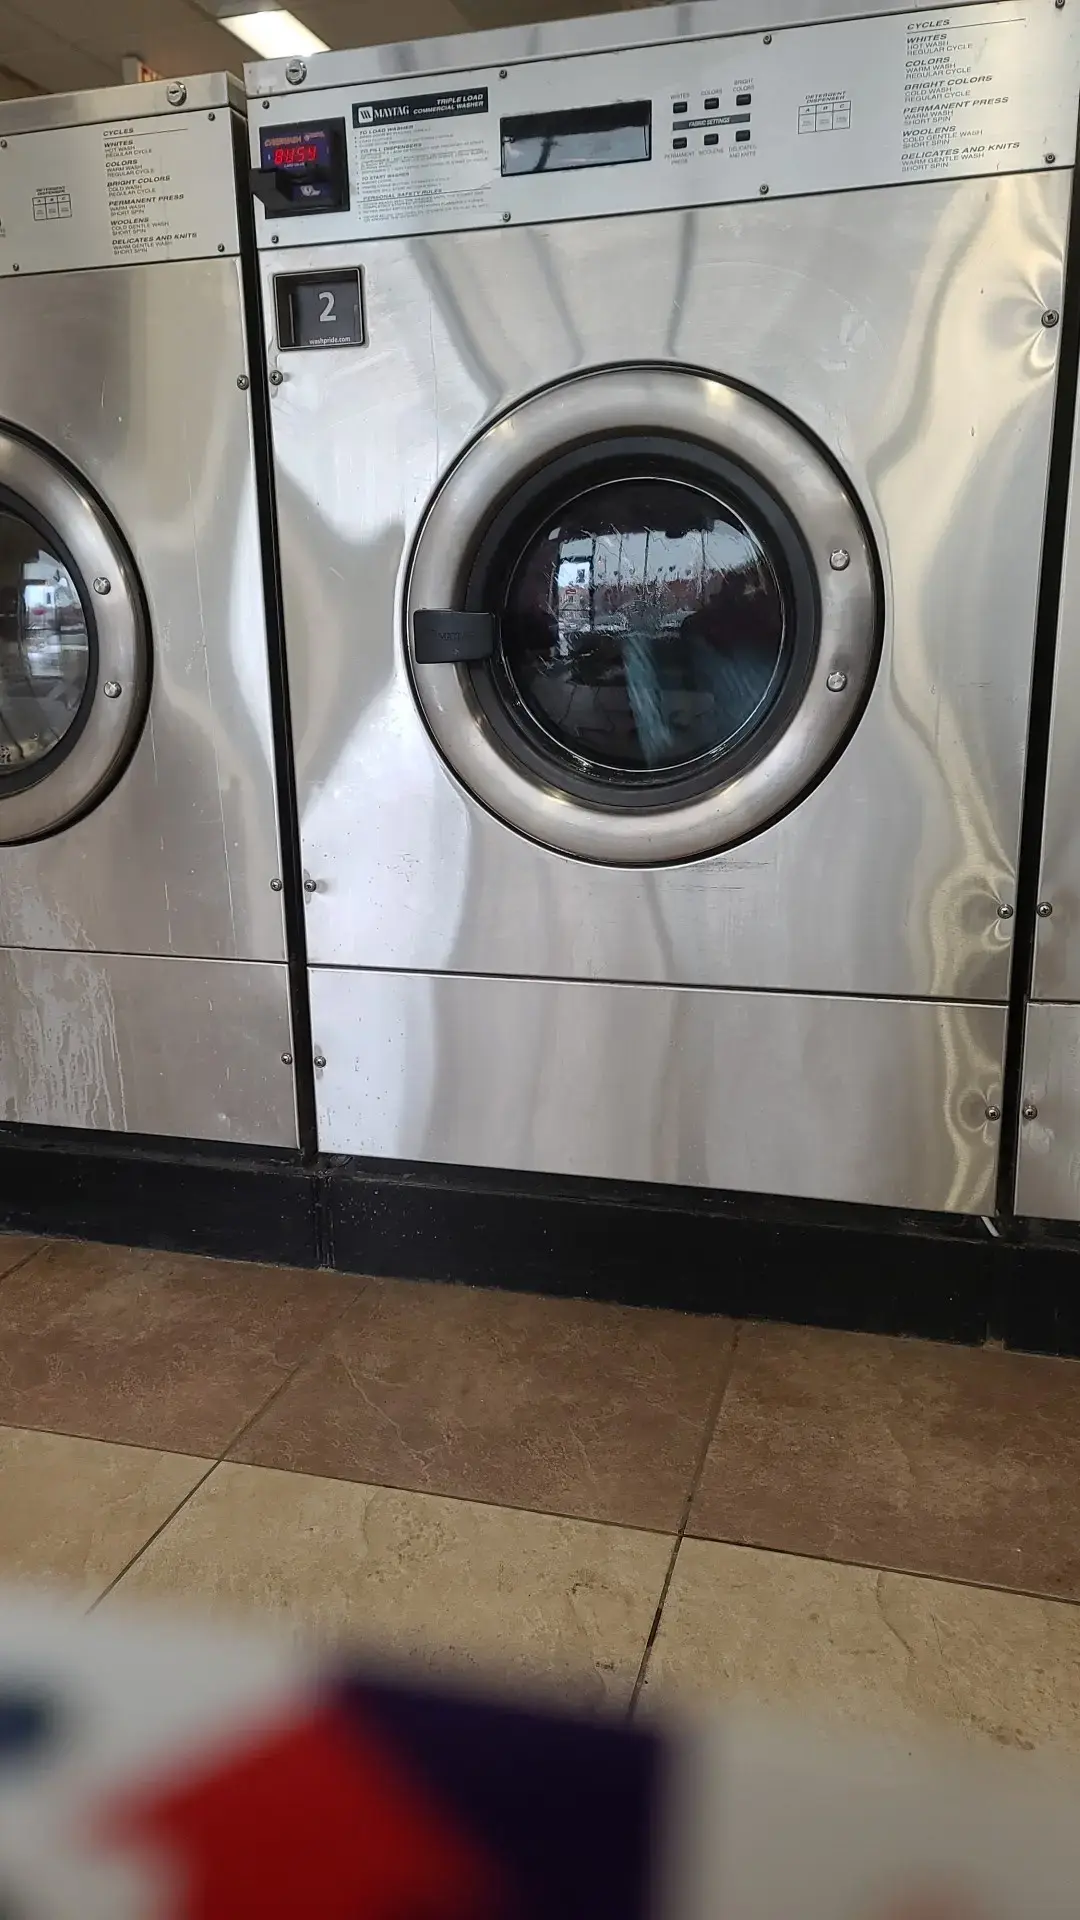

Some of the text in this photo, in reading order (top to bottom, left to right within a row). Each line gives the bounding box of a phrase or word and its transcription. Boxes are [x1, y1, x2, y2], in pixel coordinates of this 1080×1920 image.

[907, 20, 949, 30] CYCLES
[907, 34, 947, 43] WHITES
[907, 43, 973, 56] REGULAR CYCLE
[905, 57, 950, 67] COLORS
[906, 67, 971, 79] REGULAR CYCLE
[905, 75, 992, 90] BRIGHT COLORS
[905, 89, 926, 97] COLD
[905, 90, 970, 102] REGULAR CYCLE
[437, 94, 483, 105] TRIPLE LOAD
[413, 105, 455, 115] COMMERCIAL
[903, 97, 1008, 114] PERMANENT PRESS
[374, 106, 409, 119] MAYTAG
[689, 117, 730, 128] FABRIC SETTINGS
[103, 128, 133, 137] CYCLES
[903, 126, 956, 137] WOOLENS
[927, 132, 957, 140] GENTLE
[104, 140, 133, 148] WHITES
[901, 142, 1020, 160] DELICATES AND KNITS
[106, 159, 138, 167] COLORS
[138, 175, 170, 183] COLORS
[109, 197, 156, 206] PERMANENT
[111, 217, 149, 226] WOOLENS
[112, 236, 154, 245] DELICATES
[319, 291, 336, 321] 2
[309, 336, 350, 345] washpride.com
